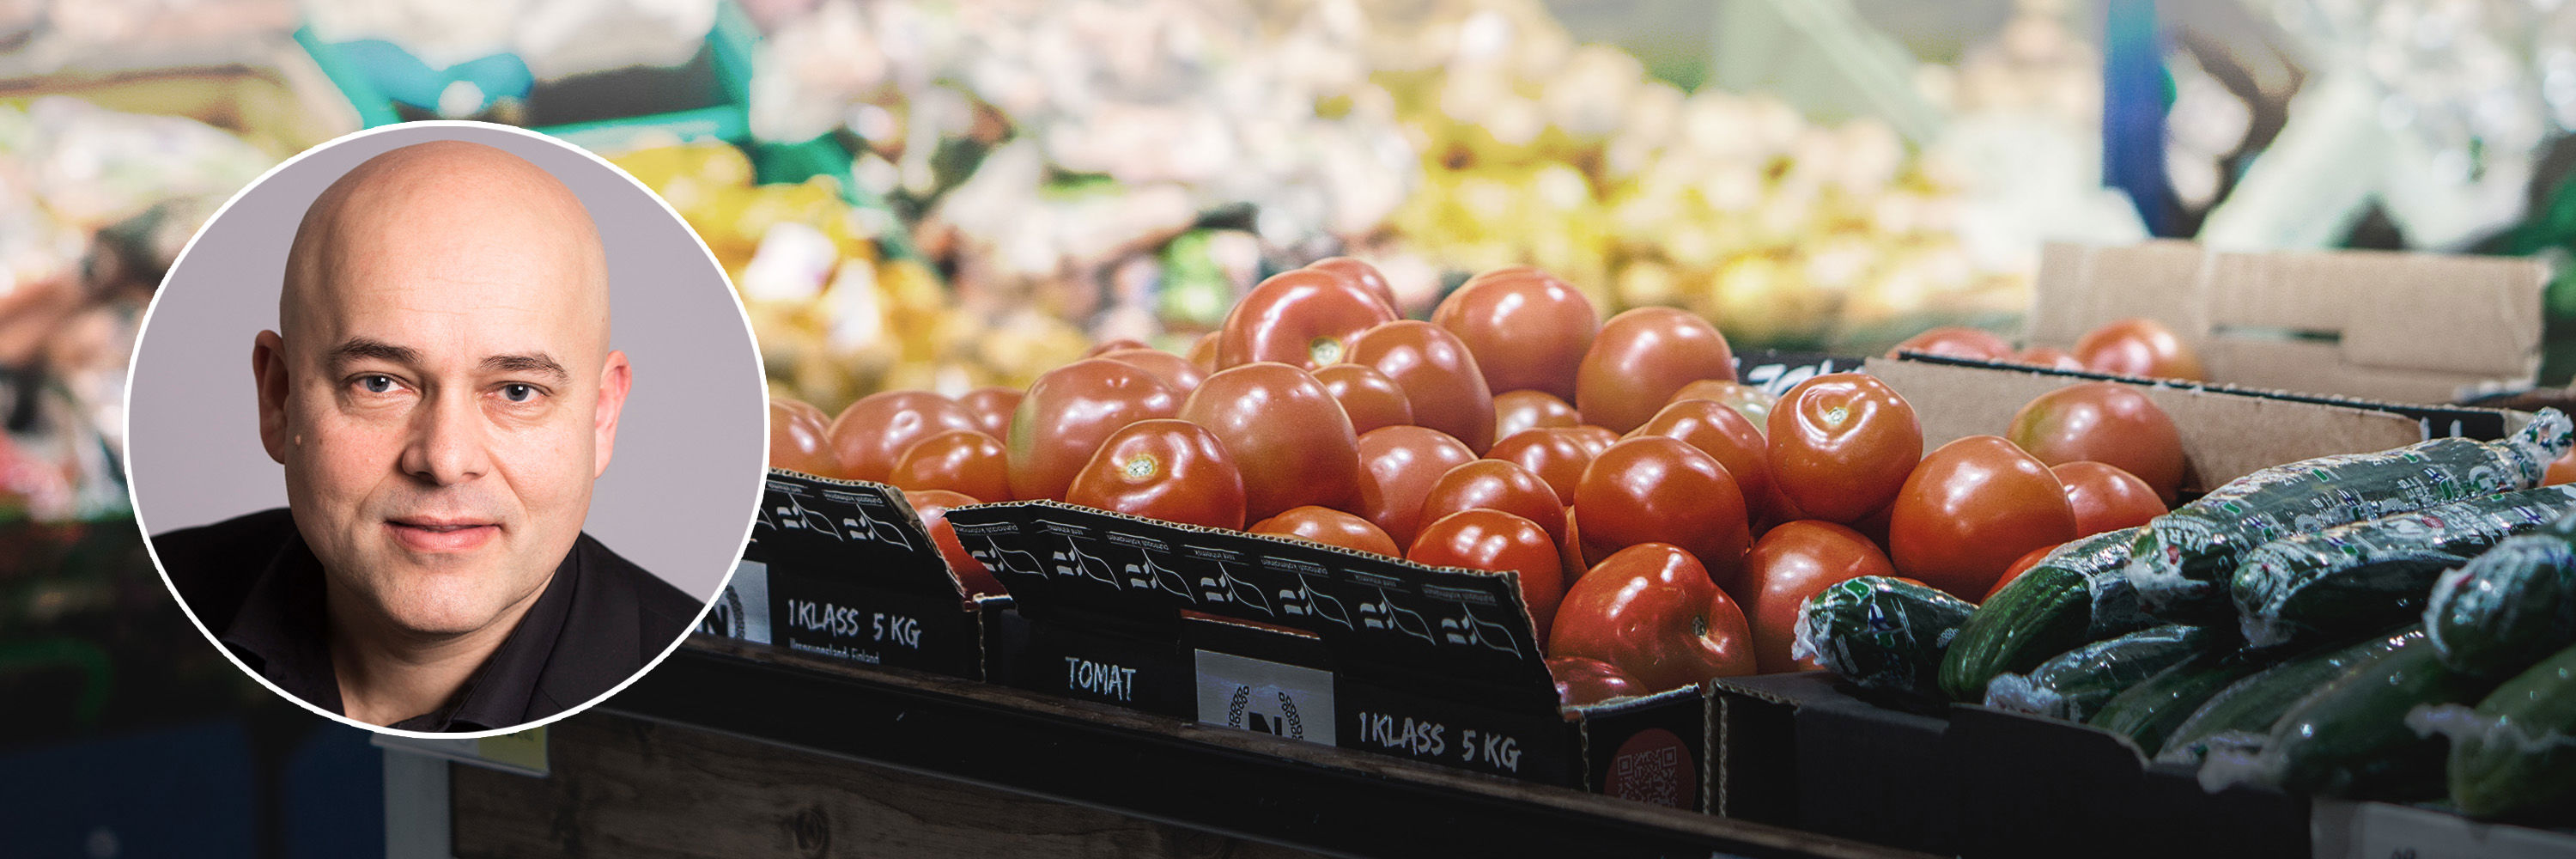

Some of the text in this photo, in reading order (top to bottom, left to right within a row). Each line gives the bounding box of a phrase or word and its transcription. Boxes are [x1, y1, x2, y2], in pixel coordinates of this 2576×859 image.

[799, 600, 859, 637] KLASS
[872, 612, 884, 641] 5
[890, 614, 922, 649] KG
[1065, 656, 1137, 701] TOMAT
[1372, 712, 1445, 756] KLASS
[1462, 729, 1477, 761] 5
[1484, 733, 1522, 772] KG
